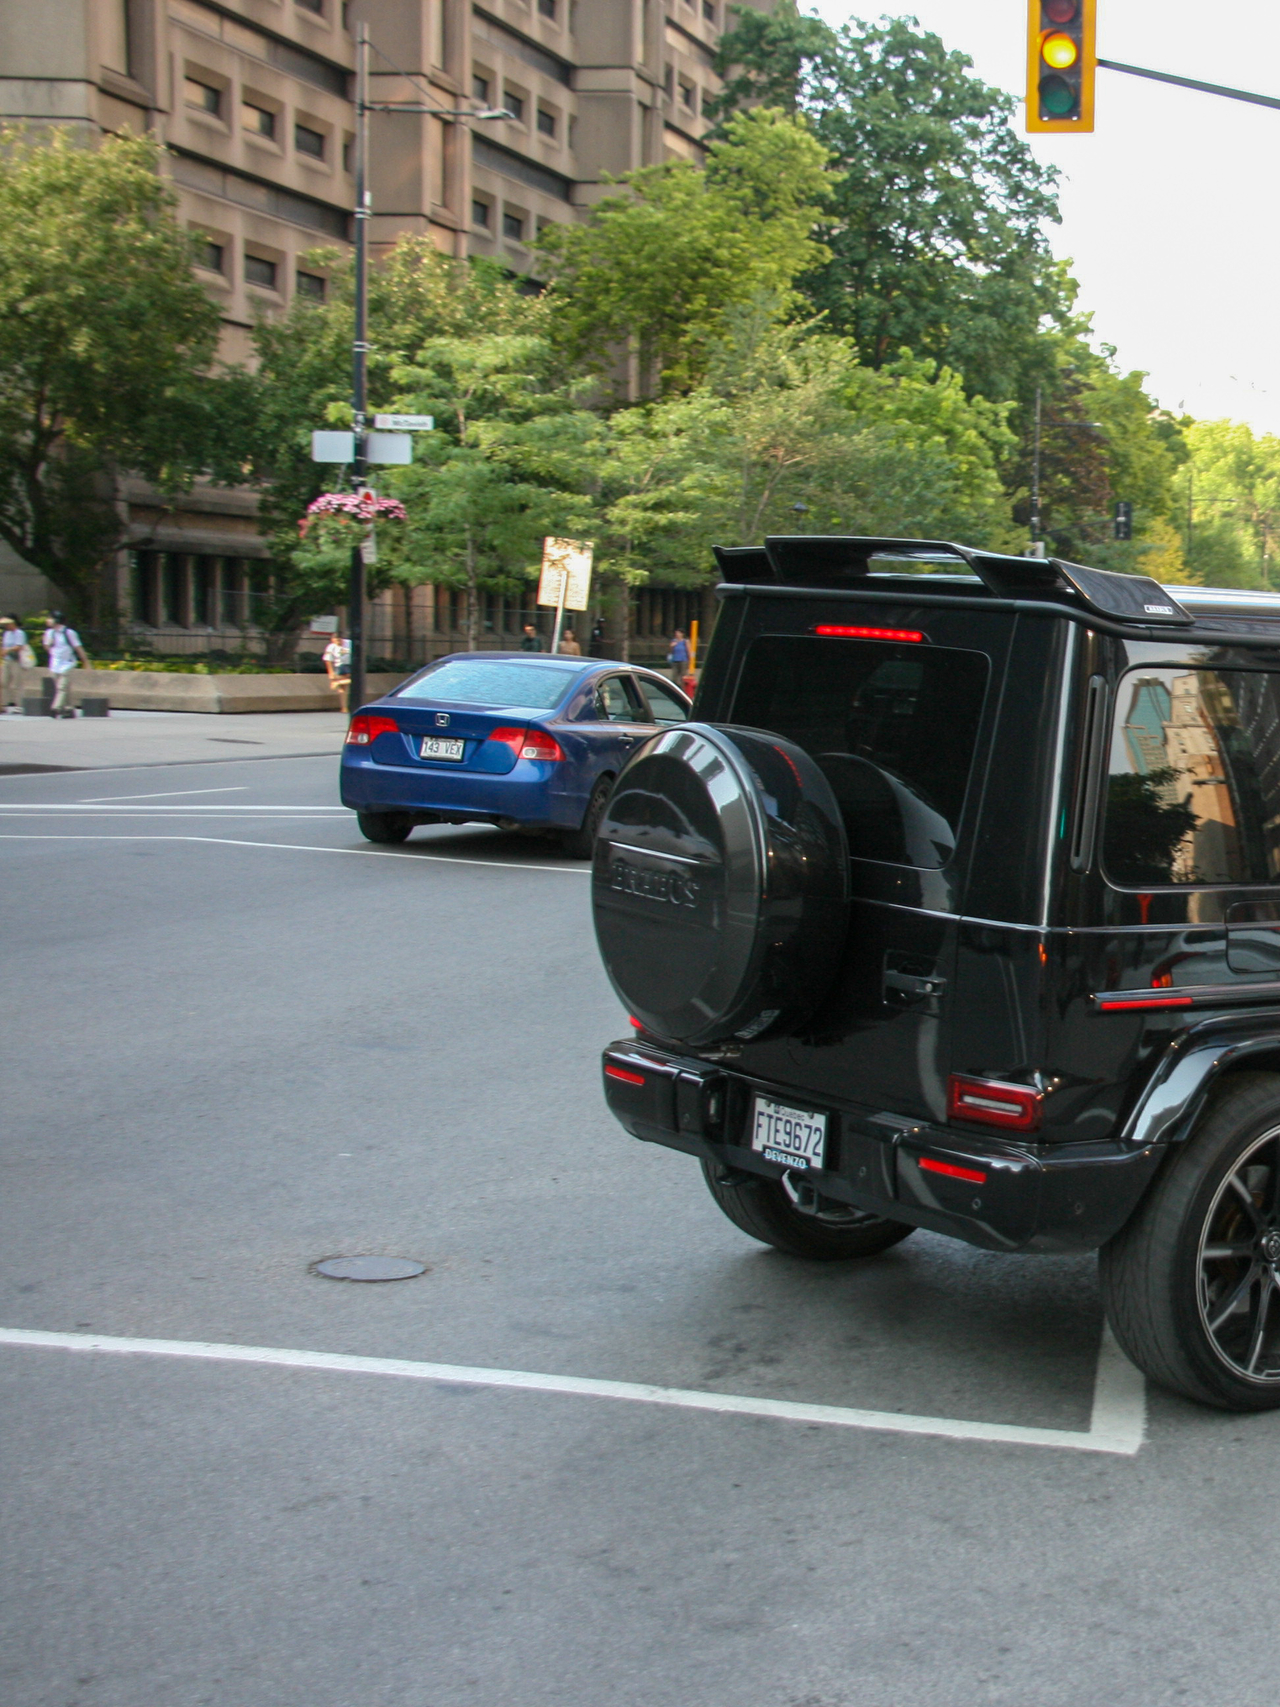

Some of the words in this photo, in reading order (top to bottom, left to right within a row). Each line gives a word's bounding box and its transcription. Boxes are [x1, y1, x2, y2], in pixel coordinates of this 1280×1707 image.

[423, 741, 440, 754] 143
[611, 863, 700, 908] BRABUS
[755, 1110, 823, 1158] FTE9672
[764, 1148, 808, 1170] DEVENZO
